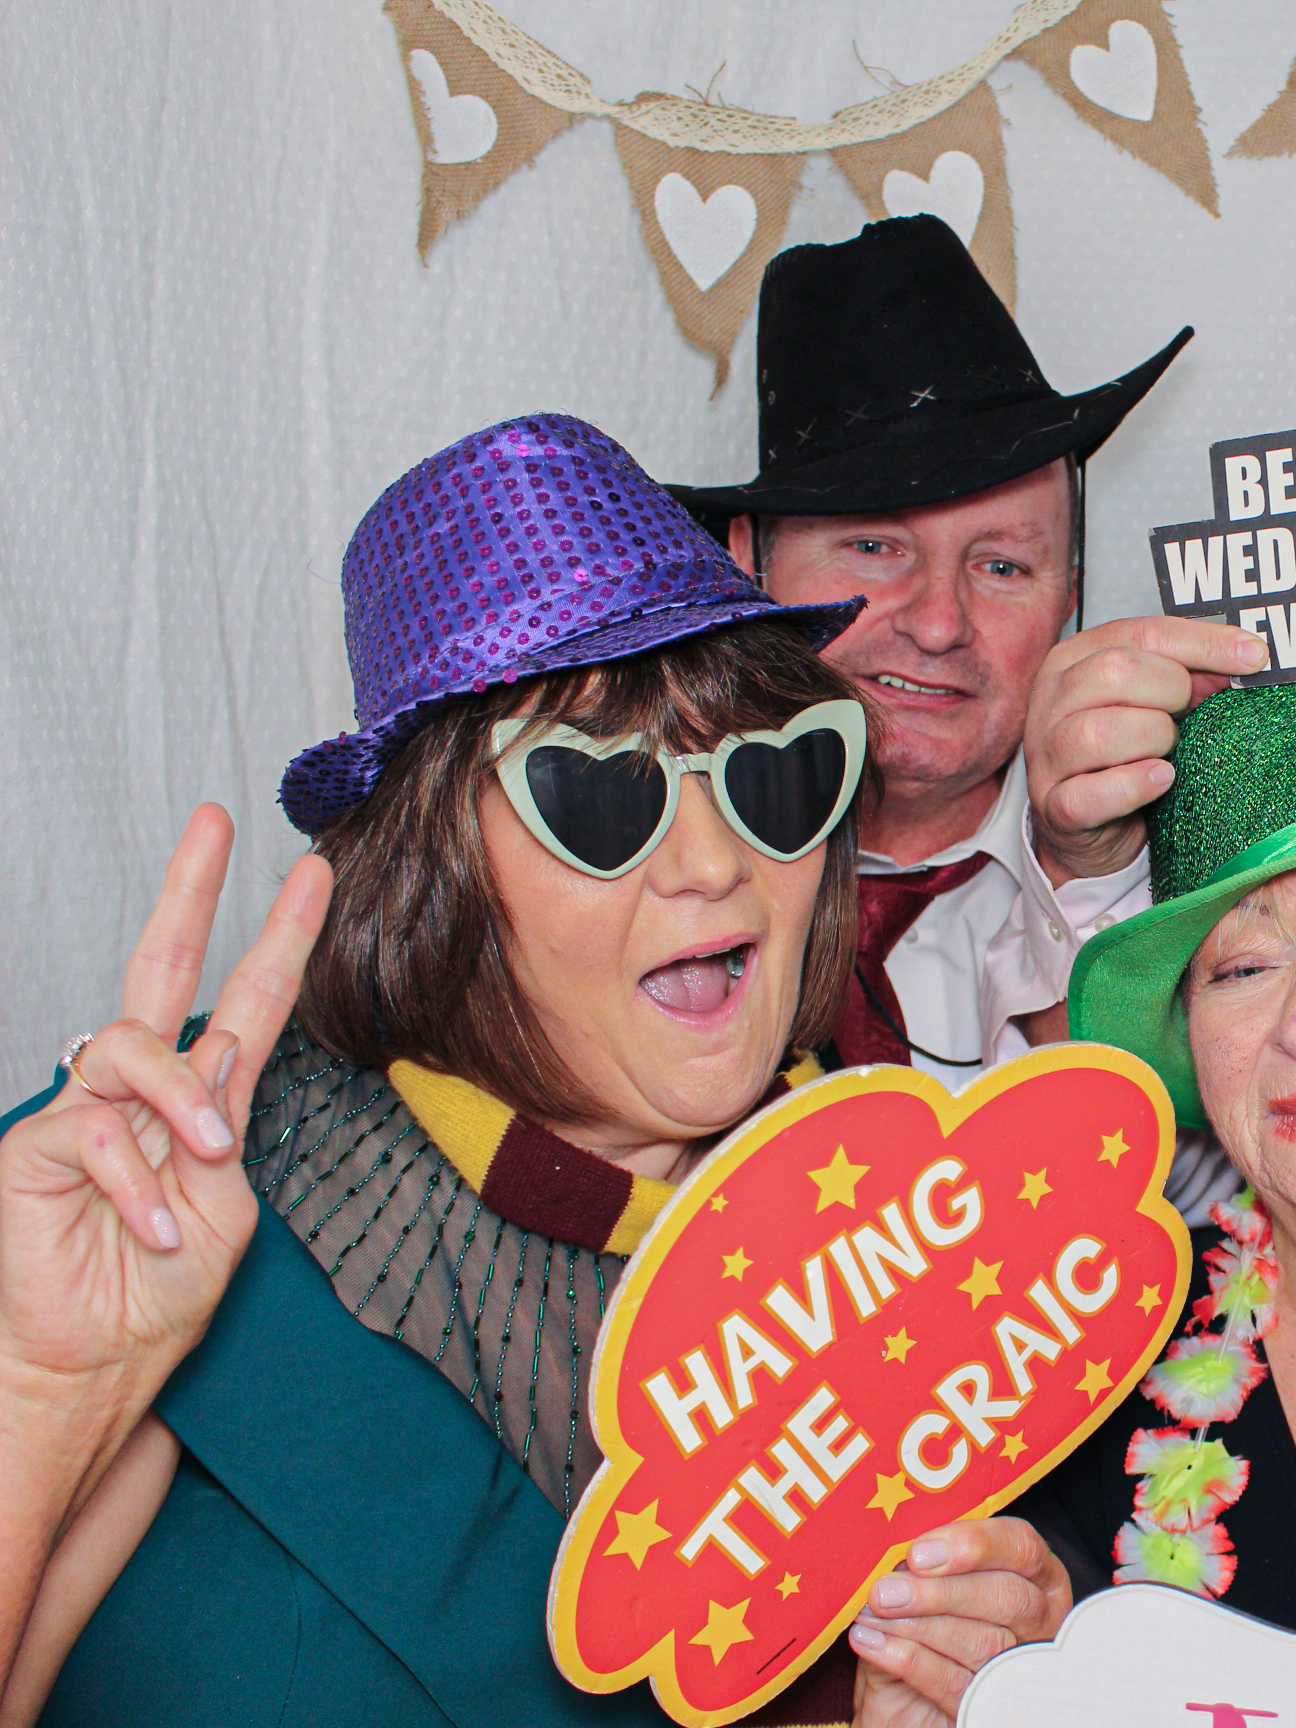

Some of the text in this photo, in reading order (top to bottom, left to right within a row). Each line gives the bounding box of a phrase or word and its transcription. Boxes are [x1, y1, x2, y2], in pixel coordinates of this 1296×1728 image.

[641, 1157, 984, 1458] HAVING
[674, 1234, 1120, 1578] THE CRAIC
